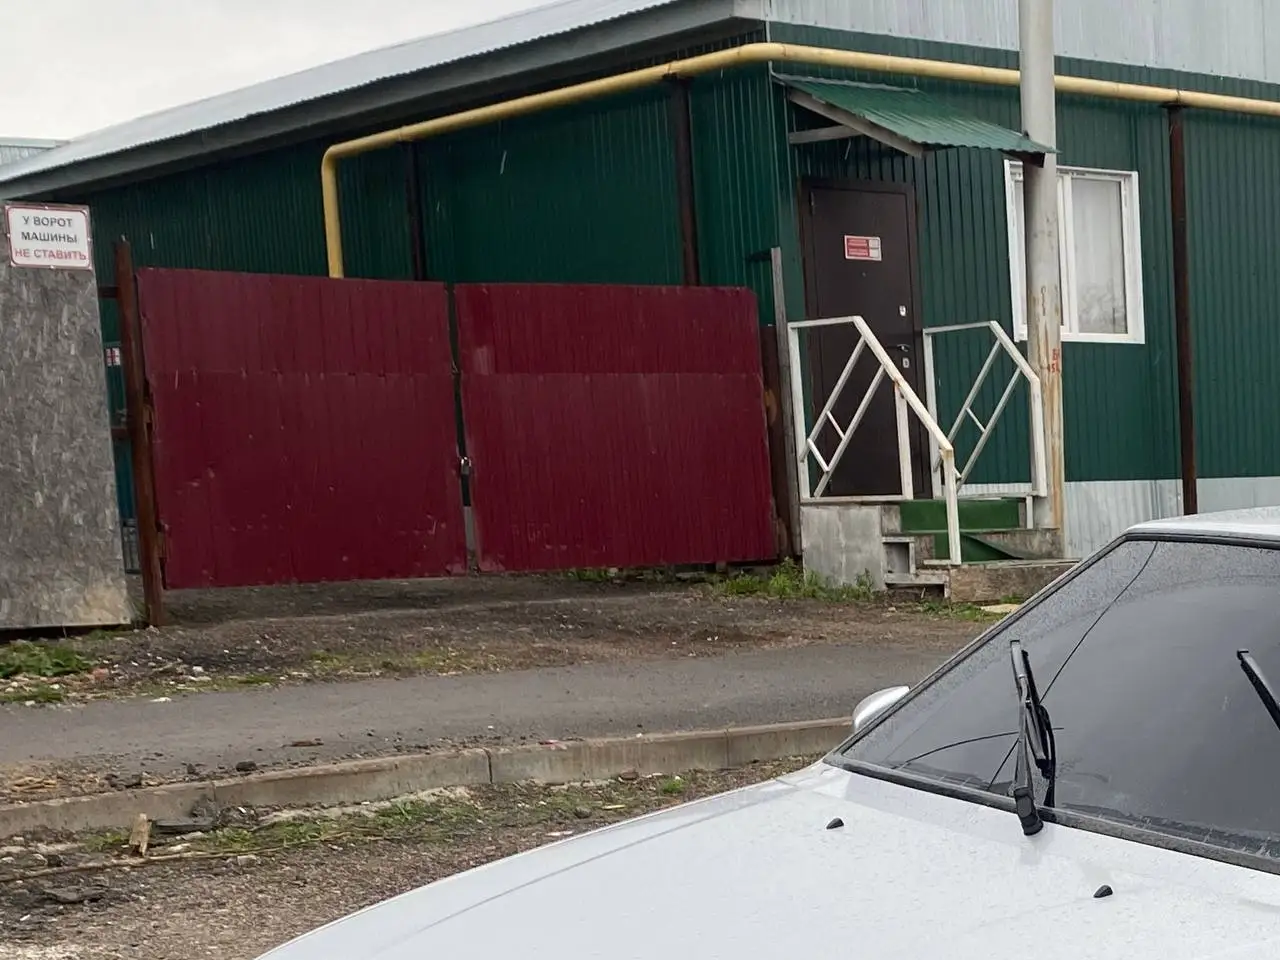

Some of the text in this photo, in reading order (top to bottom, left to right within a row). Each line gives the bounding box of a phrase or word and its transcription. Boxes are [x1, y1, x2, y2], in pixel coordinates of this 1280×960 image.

[22, 215, 73, 227] У ВОРОТ
[21, 231, 77, 243] МАШИНЫ
[15, 248, 87, 261] НЕ СТАВИТЬ
